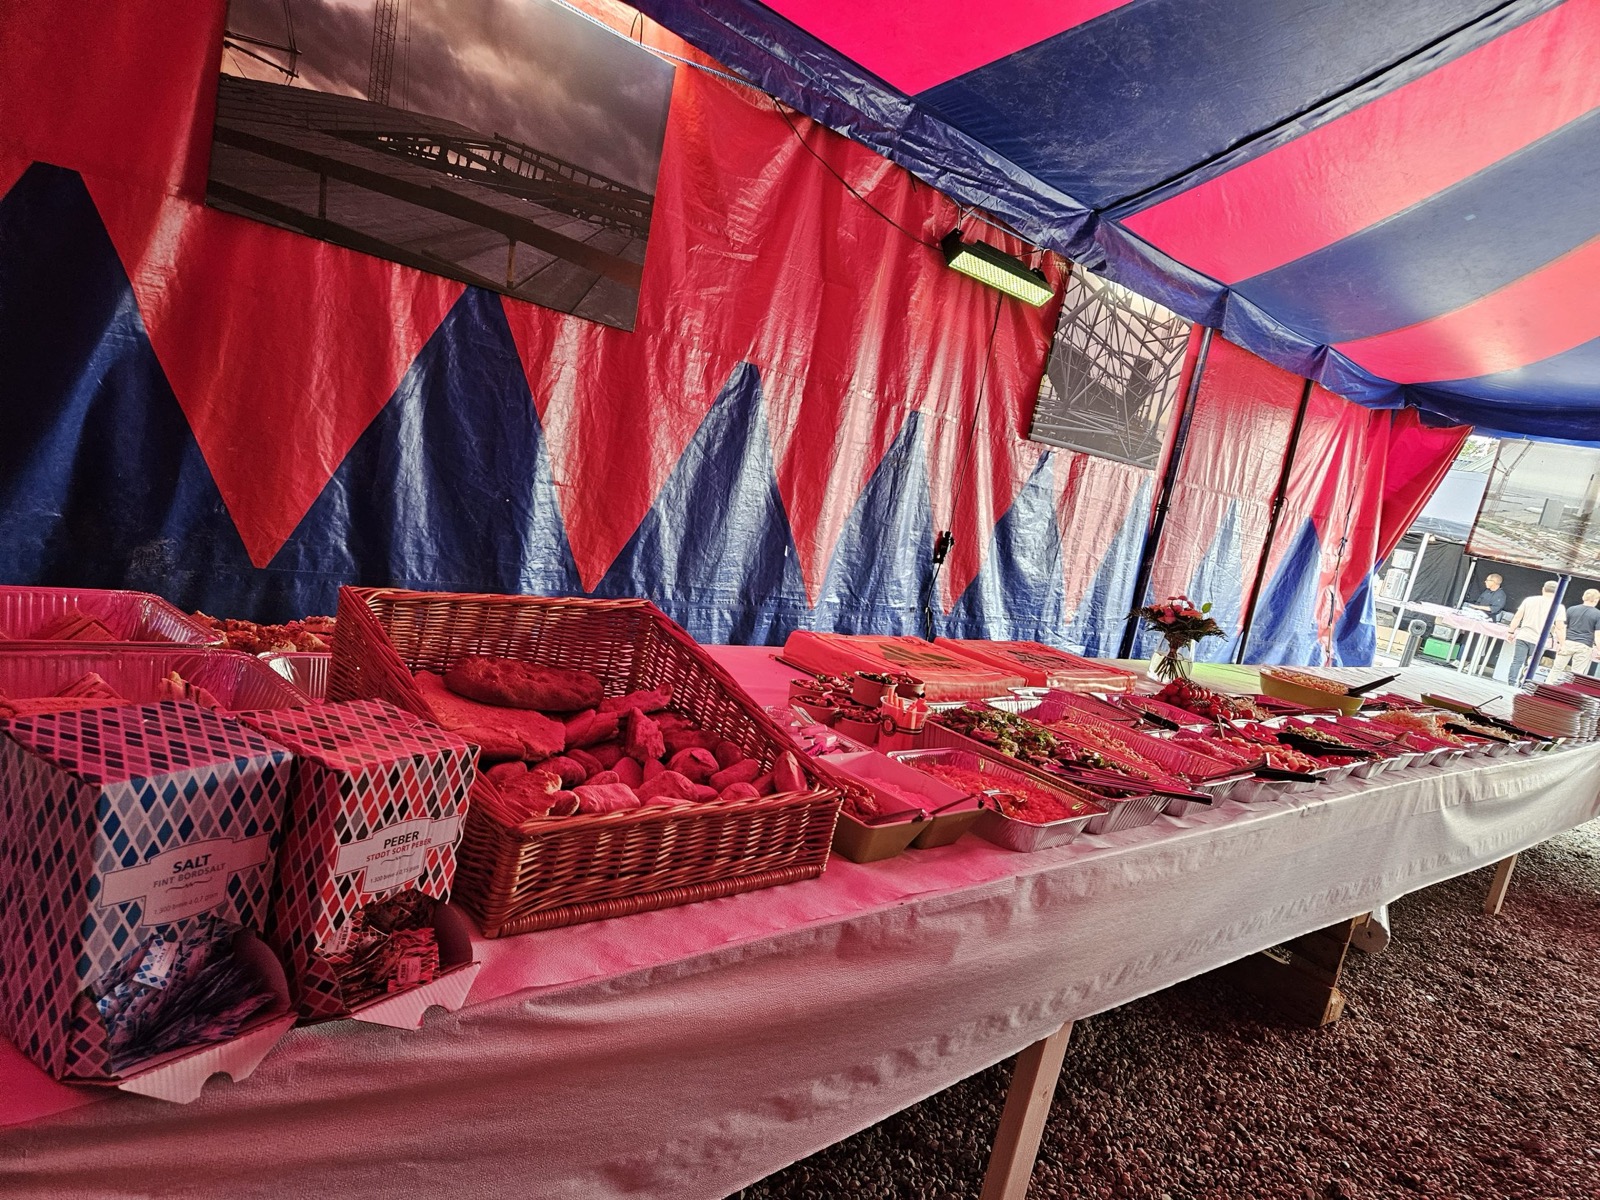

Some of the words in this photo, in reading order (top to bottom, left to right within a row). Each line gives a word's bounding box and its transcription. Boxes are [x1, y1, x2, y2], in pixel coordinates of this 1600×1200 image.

[366, 850, 390, 862] STØDT
[392, 844, 410, 855] SORT
[411, 838, 432, 849] PEBER
[383, 831, 420, 849] PEBER
[172, 853, 212, 874] SALT
[153, 876, 175, 888] FINT
[178, 862, 226, 881] BORDSALT
